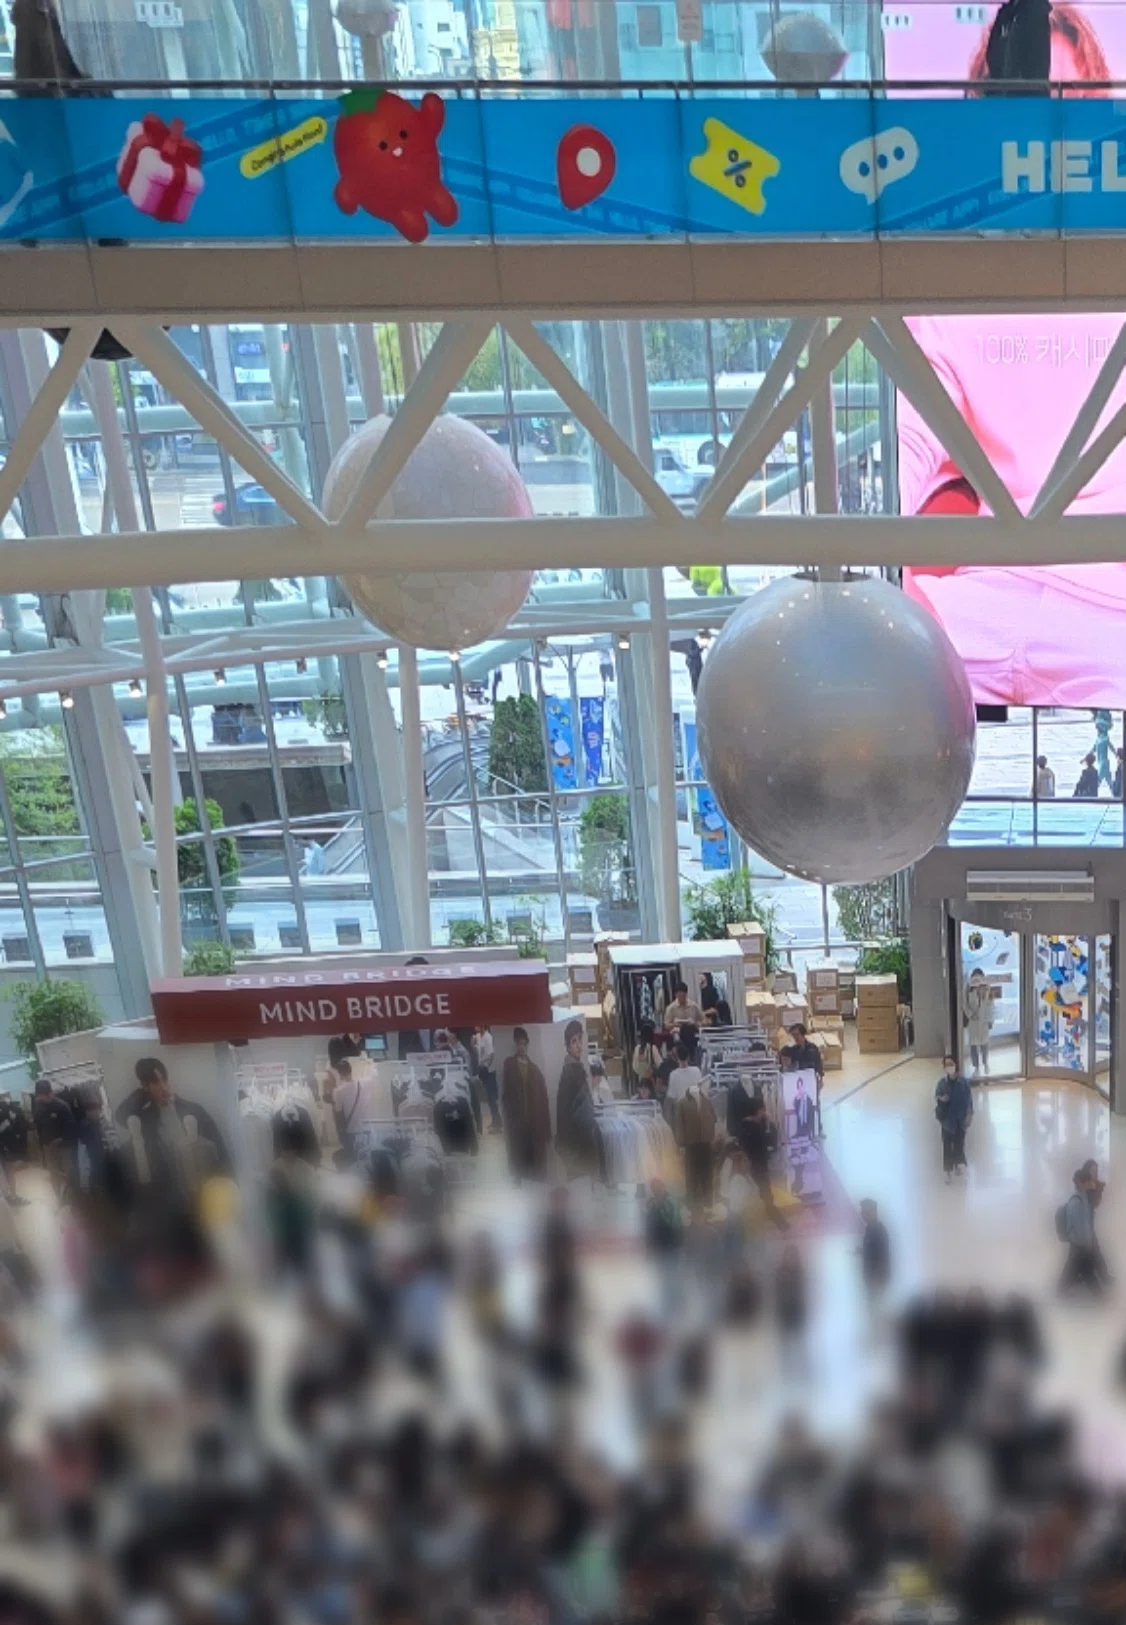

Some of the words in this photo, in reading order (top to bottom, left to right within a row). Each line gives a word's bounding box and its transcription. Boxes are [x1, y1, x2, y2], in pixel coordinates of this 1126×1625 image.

[225, 973, 323, 988] MIND
[343, 964, 477, 981] BRIDGE
[258, 998, 337, 1025] MIND
[347, 992, 451, 1021] BRIDGE
